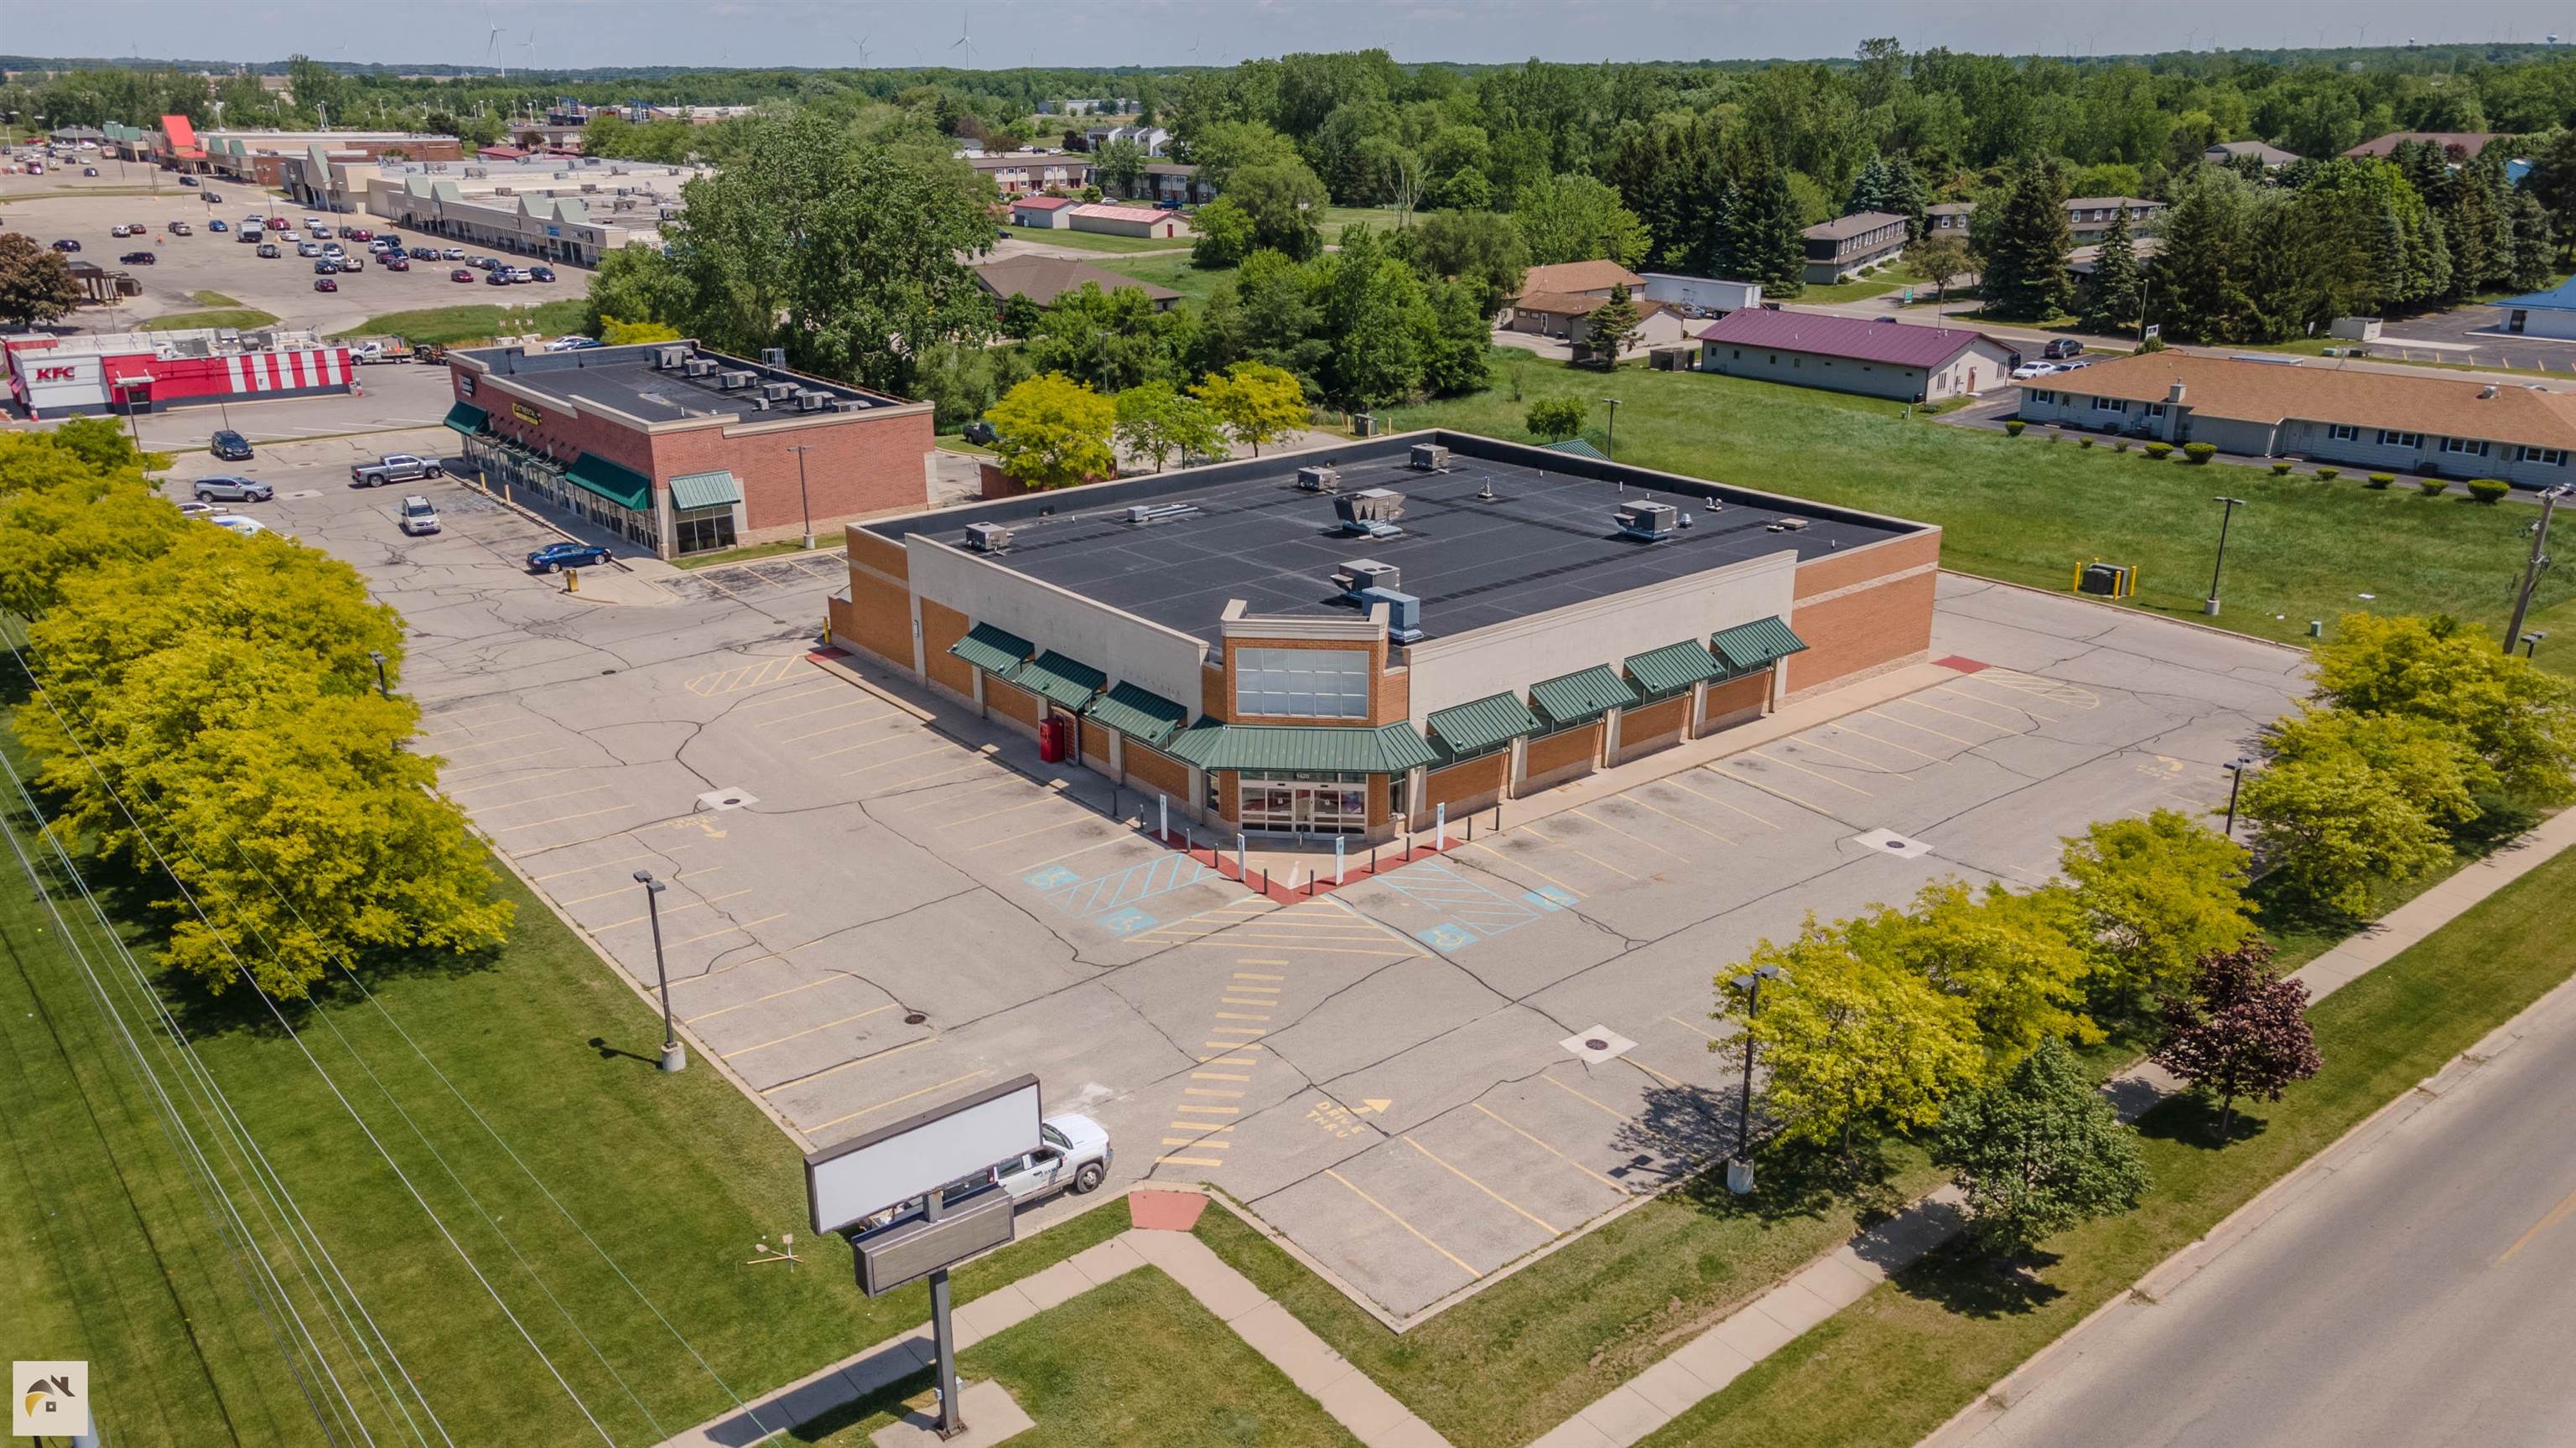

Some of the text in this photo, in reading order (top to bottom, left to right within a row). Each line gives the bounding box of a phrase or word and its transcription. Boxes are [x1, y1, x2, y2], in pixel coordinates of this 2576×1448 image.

[36, 366, 75, 380] KFC
[1306, 1109, 1349, 1138] THRU
[1316, 1100, 1366, 1134] DRIVE
